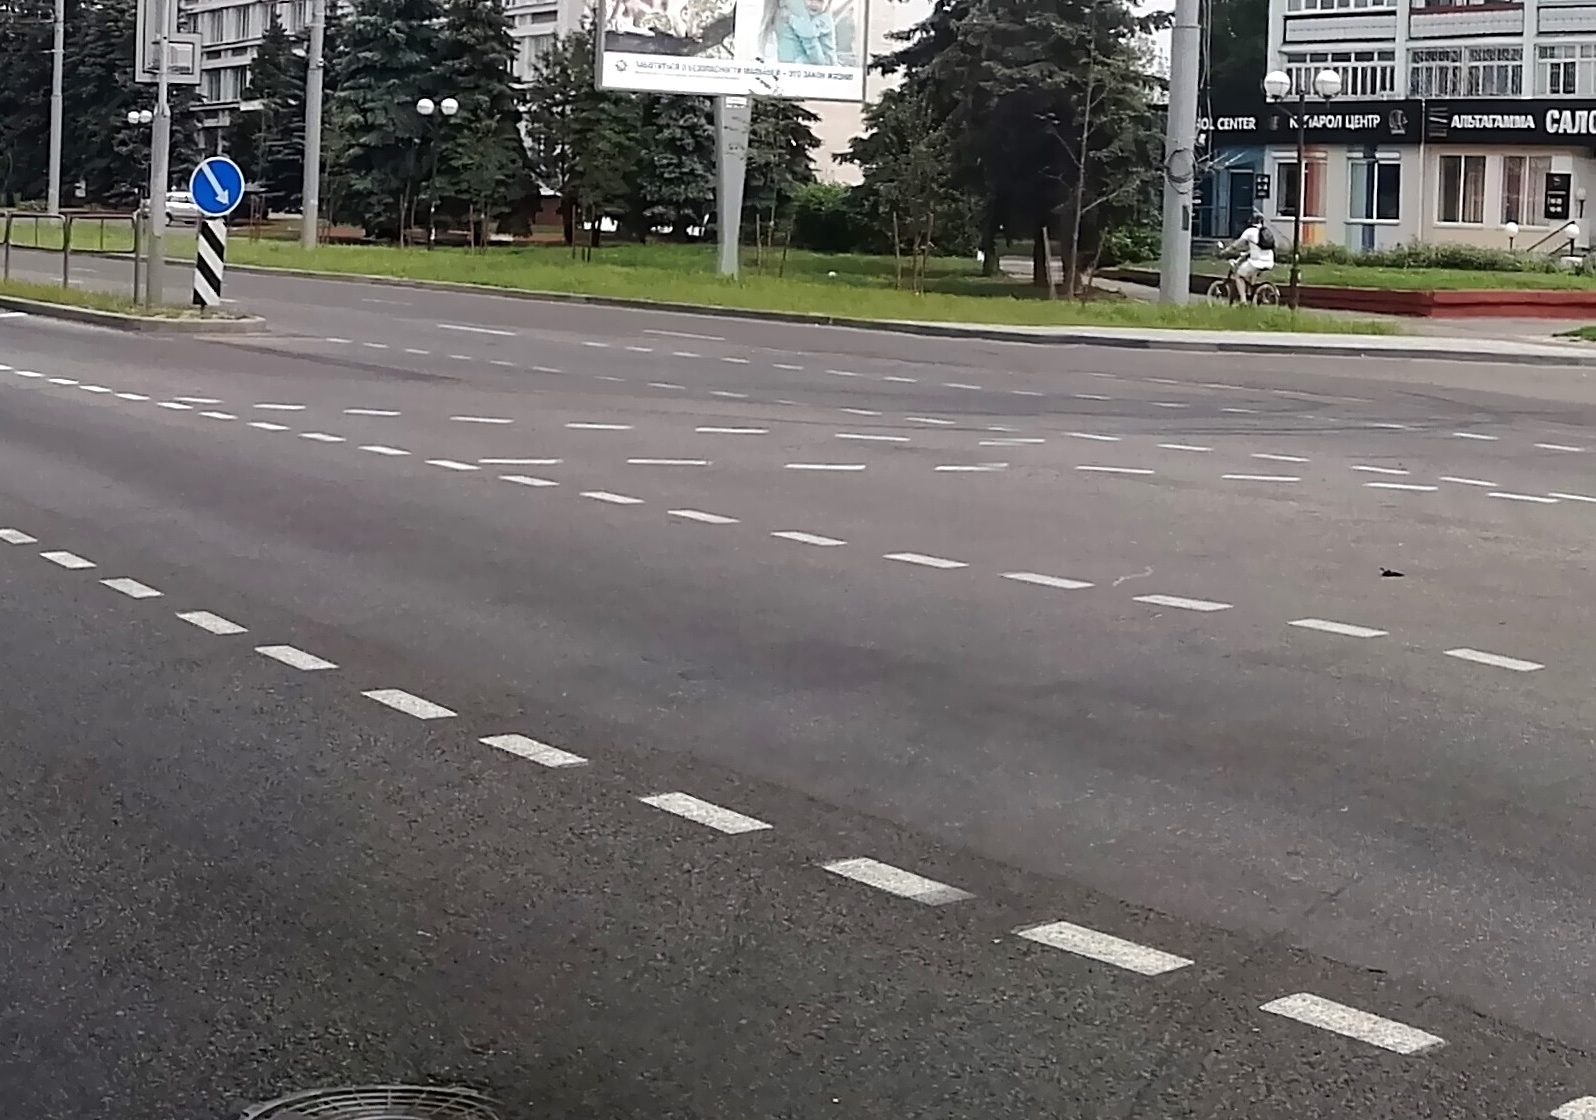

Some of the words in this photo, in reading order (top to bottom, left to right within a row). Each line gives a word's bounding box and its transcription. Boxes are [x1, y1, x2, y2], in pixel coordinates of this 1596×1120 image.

[1217, 117, 1256, 130] CENTER
[1345, 114, 1381, 130] ЦЕНТР
[1450, 114, 1536, 129] АЛЬТАГАММА
